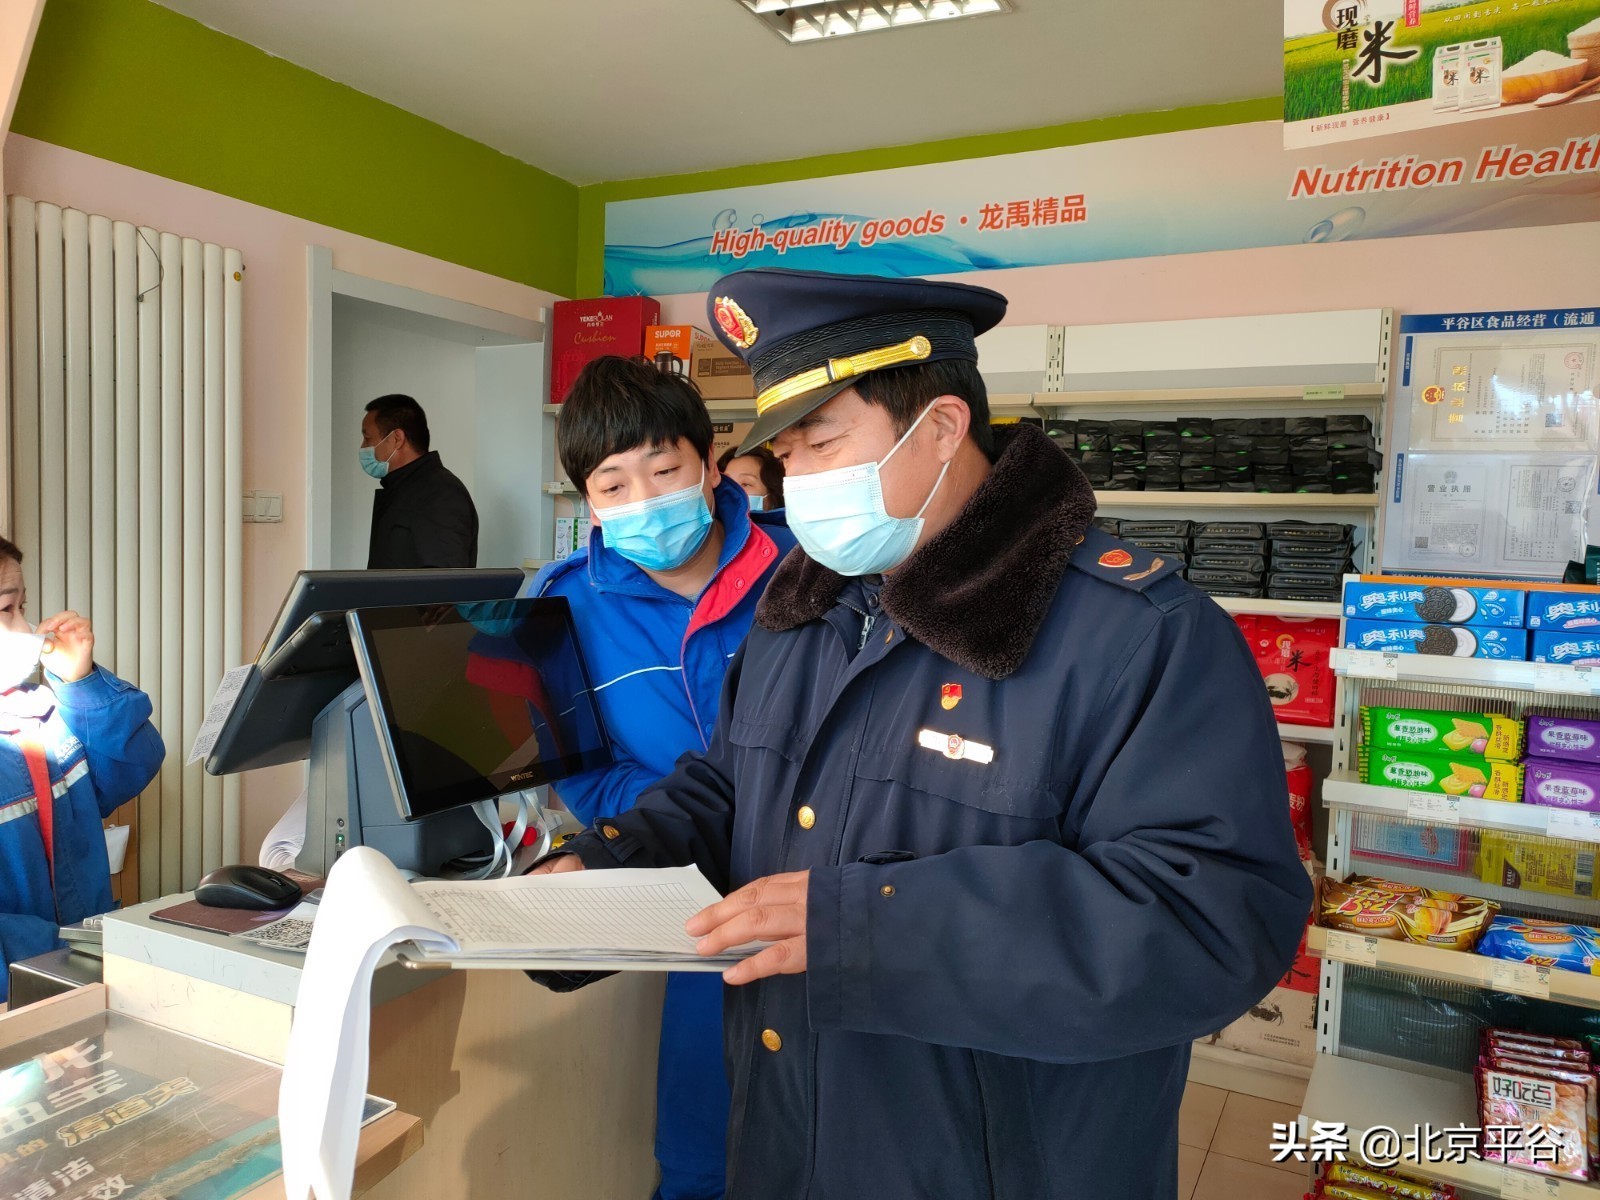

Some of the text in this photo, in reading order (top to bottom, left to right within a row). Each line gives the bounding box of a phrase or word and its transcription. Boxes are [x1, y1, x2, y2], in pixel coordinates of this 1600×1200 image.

[1335, 5, 1359, 51] 现磨
[1351, 20, 1418, 84] 米
[1291, 155, 1463, 198] Nutrition
[710, 193, 1087, 256] High-quality goods 龙禹精品
[574, 330, 617, 345] Cushion
[654, 329, 681, 339] SUPOR
[1427, 484, 1472, 493] 营业执照
[1360, 590, 1425, 610] 奥利奥
[1361, 629, 1426, 647] 奥利奥
[1286, 649, 1312, 673] 米
[1343, 895, 1388, 916] 3+2
[1492, 1076, 1552, 1106] 好吃点
[58, 1077, 198, 1147] 清道夫
